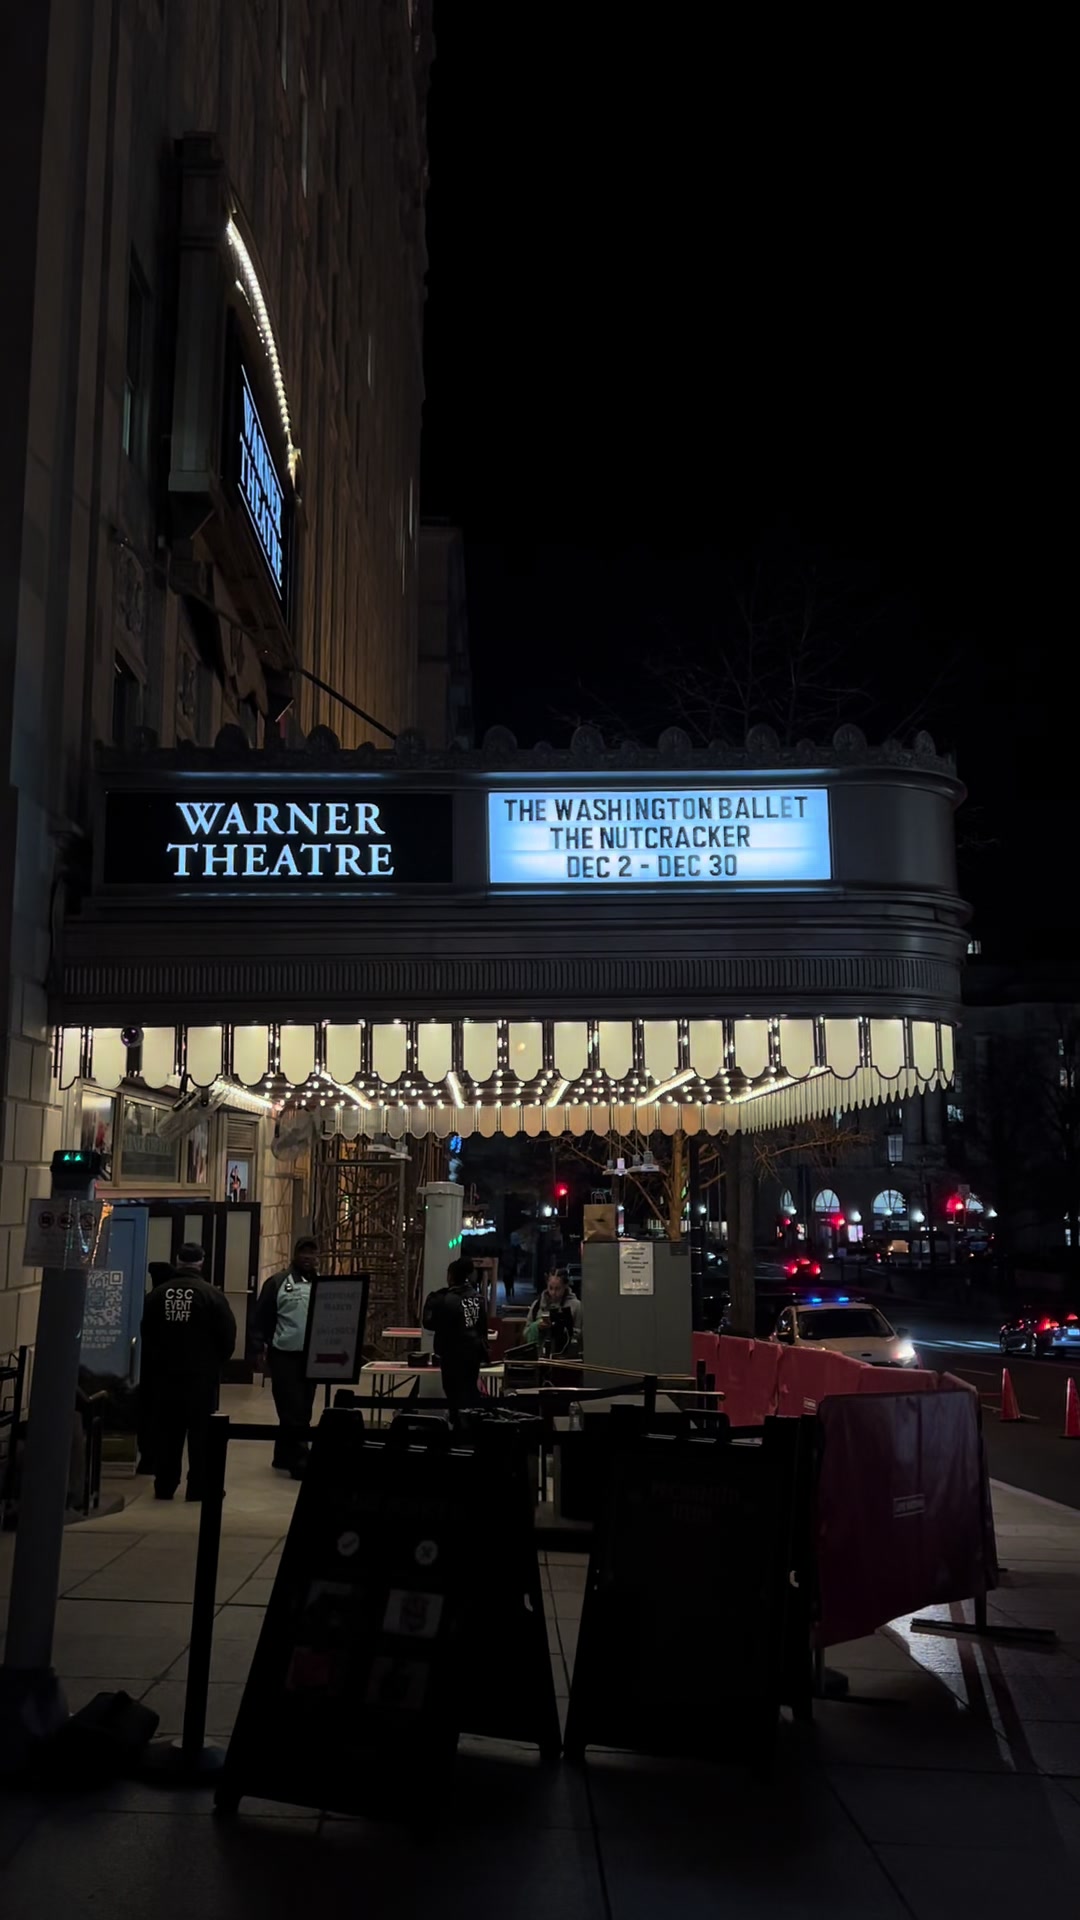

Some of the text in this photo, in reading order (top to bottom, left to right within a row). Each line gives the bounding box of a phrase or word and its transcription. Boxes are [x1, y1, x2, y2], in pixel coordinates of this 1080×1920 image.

[175, 802, 387, 835] WARNER
[504, 795, 809, 822] THE WASHINGTON BALLET
[550, 825, 751, 850] THE NUTCRACKER
[166, 842, 395, 876] THEATRE
[567, 855, 610, 879] DEC
[618, 855, 632, 878] 2
[658, 854, 701, 878] DEC
[709, 854, 738, 877] 30
[165, 1288, 194, 1300] CSC
[165, 1299, 193, 1311] EVENT
[461, 1297, 480, 1308] CSC
[165, 1310, 192, 1323] STAFF
